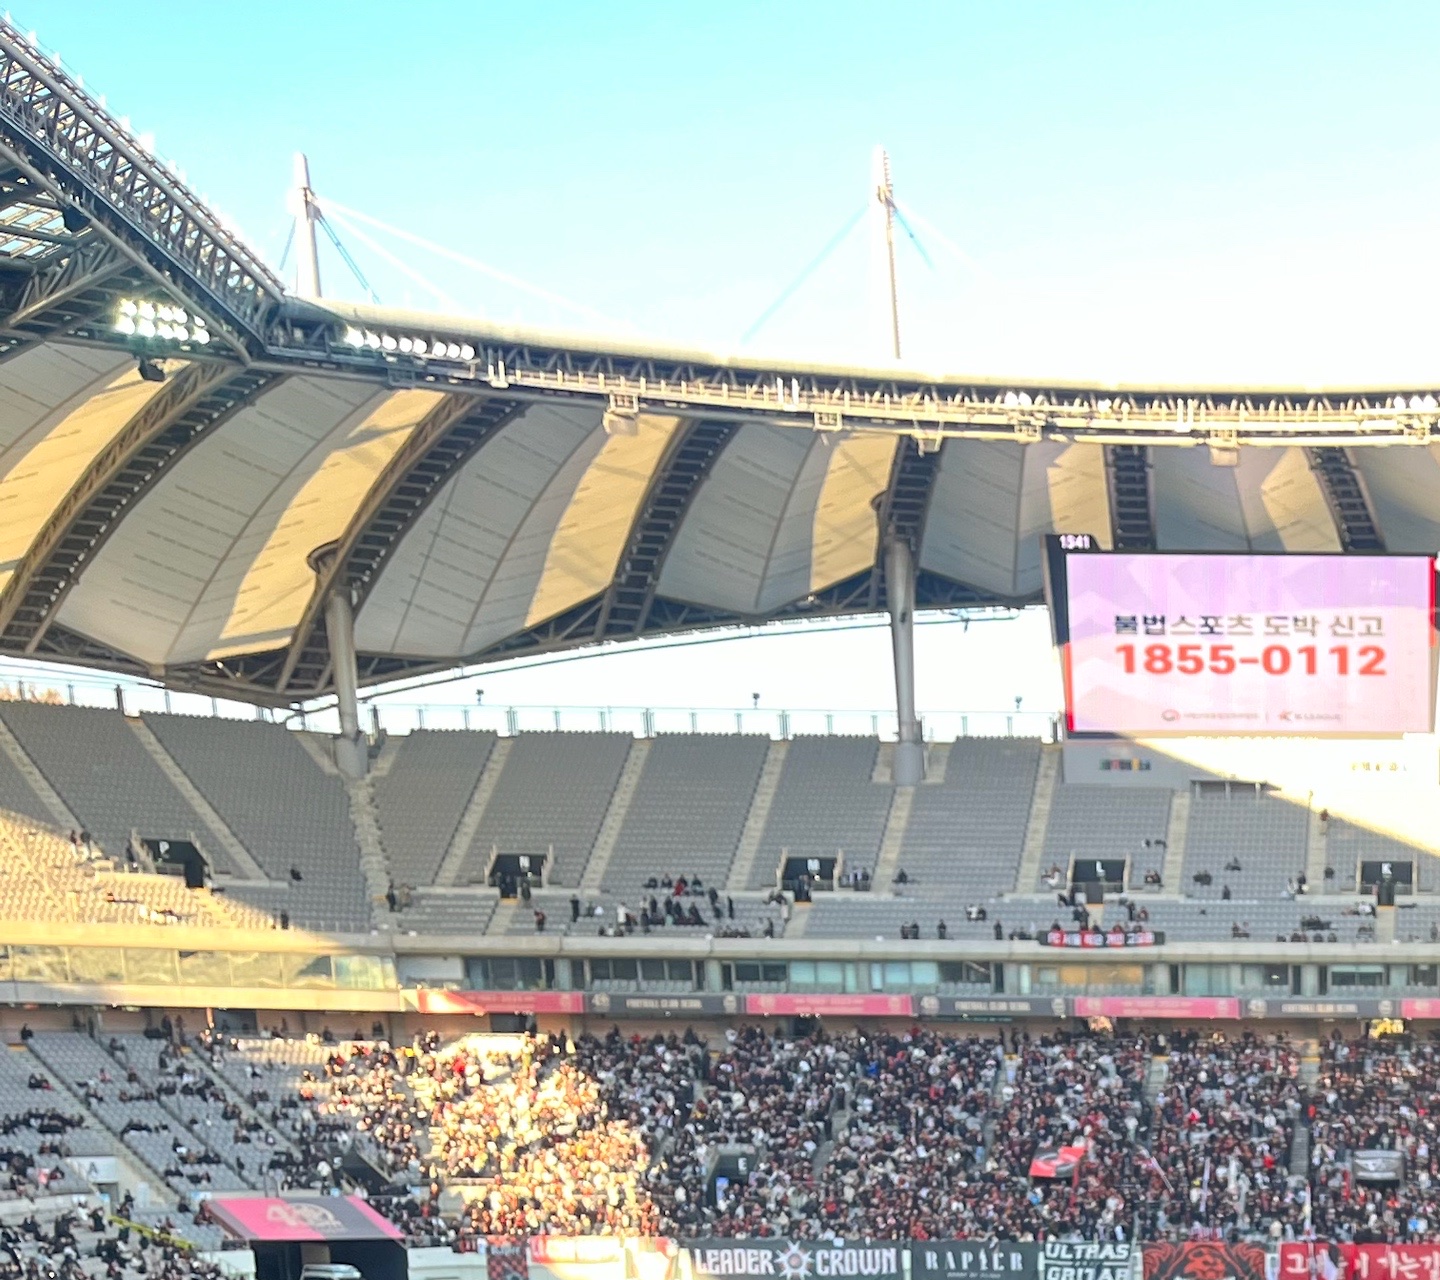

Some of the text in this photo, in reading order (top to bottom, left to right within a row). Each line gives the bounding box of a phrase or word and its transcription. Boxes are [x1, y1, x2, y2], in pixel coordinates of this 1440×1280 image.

[1113, 614, 1385, 637] 불법스포츠 도박 신고
[1114, 643, 1387, 676] 1855-0112
[694, 1248, 897, 1276] LEADER CROWN
[1045, 1243, 1130, 1260] ULTRAS
